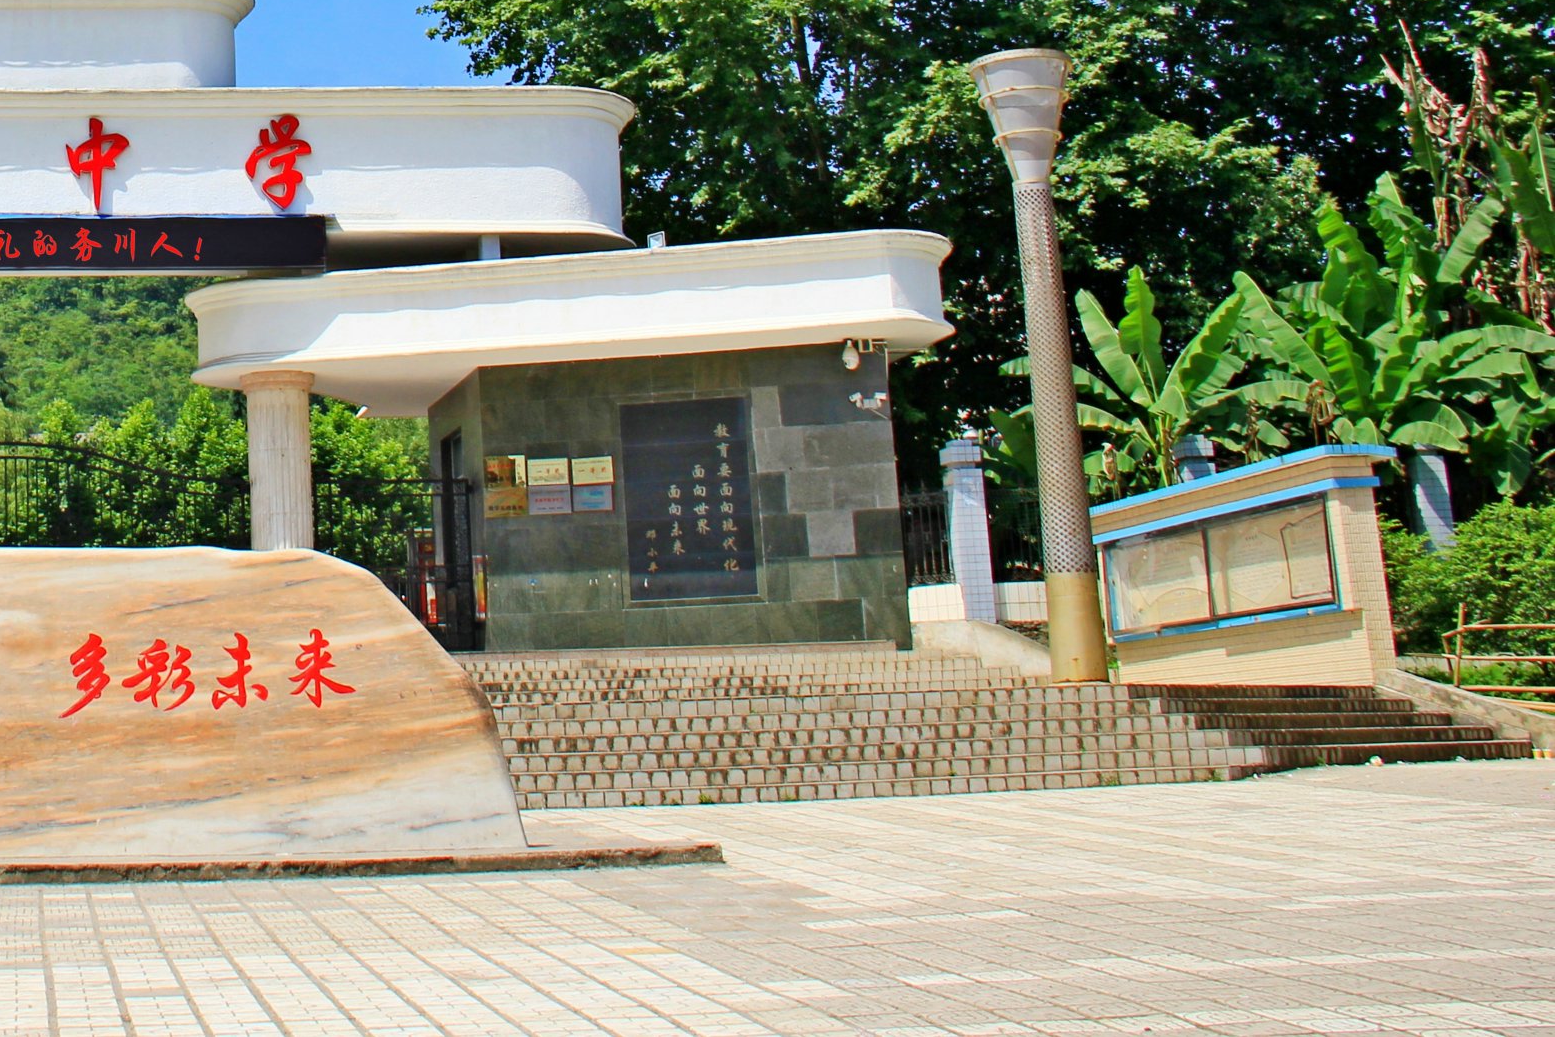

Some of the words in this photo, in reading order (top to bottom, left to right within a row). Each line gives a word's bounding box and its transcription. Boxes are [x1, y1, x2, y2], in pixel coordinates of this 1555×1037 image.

[667, 484, 686, 556] 面向未来
[692, 464, 711, 535] 面向世界
[713, 422, 740, 572] 教育要面向现代化
[59, 628, 357, 719] 多彩未来
